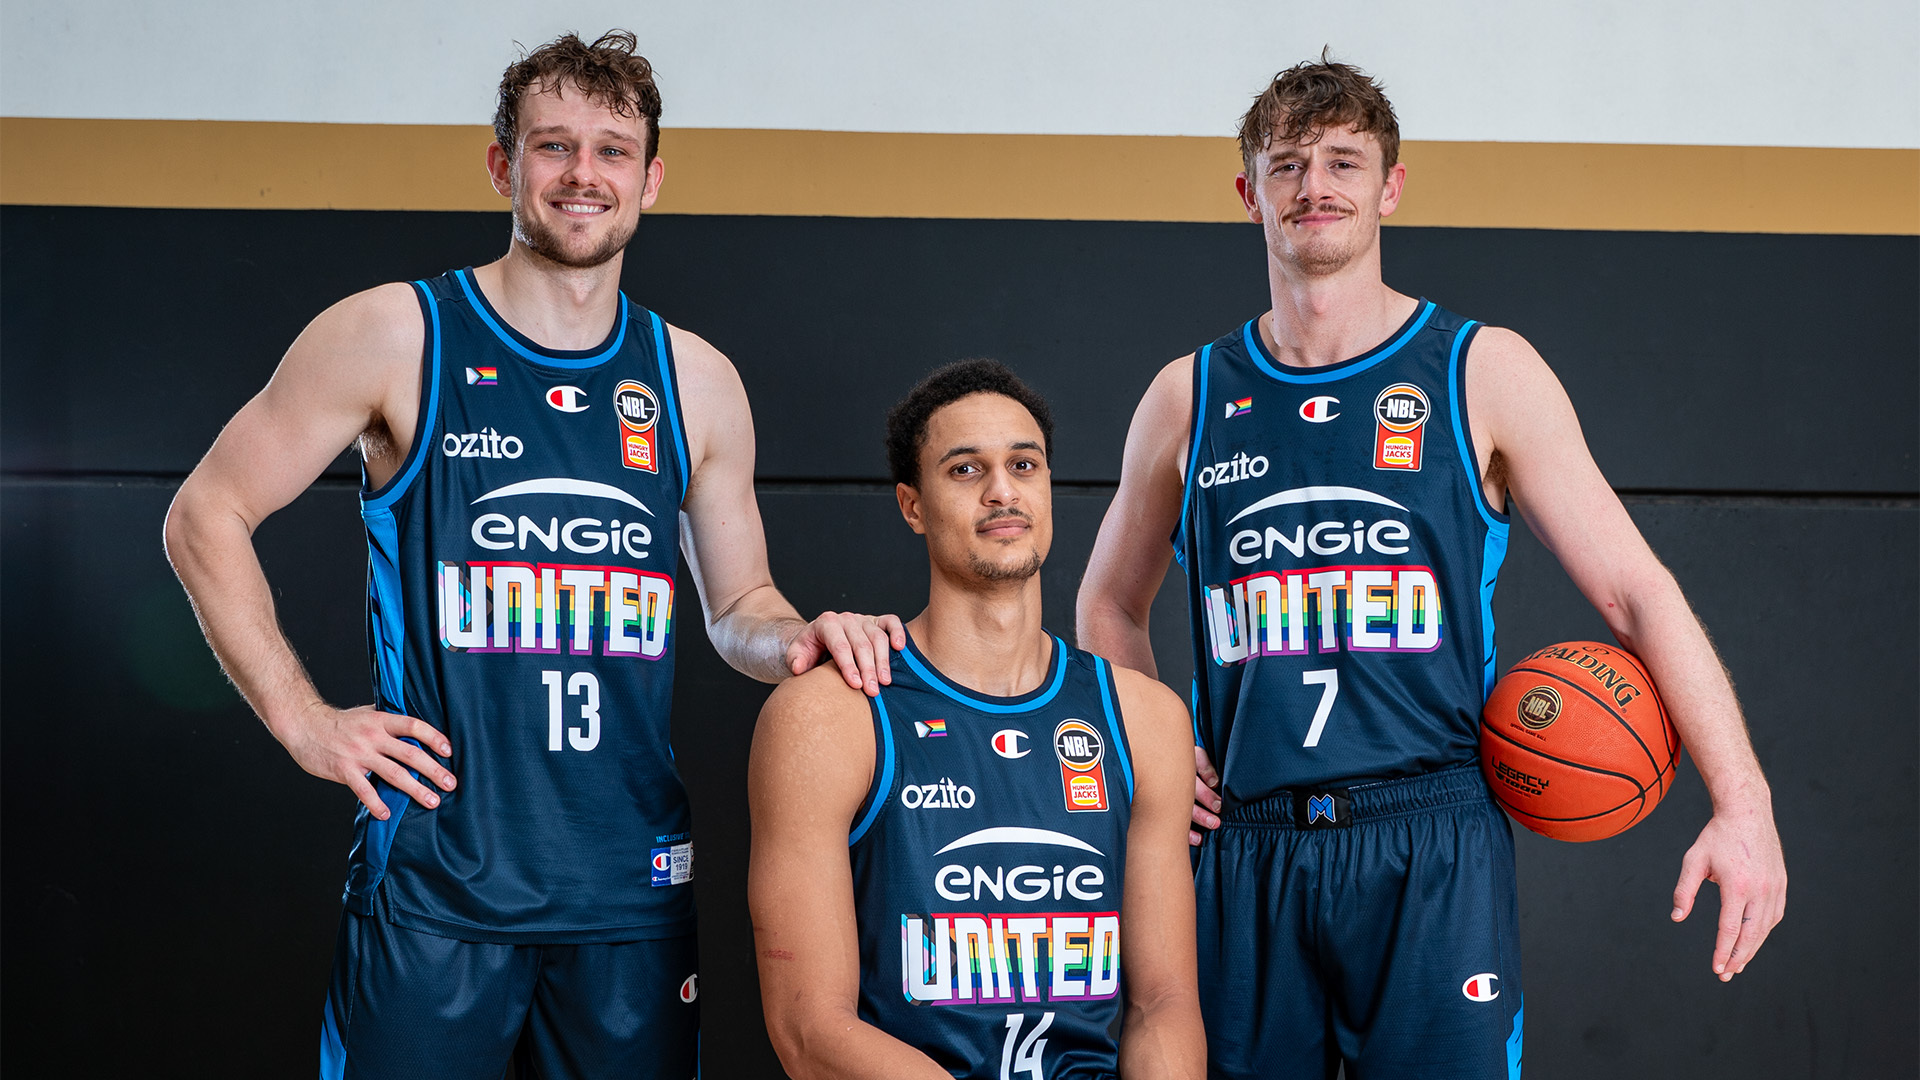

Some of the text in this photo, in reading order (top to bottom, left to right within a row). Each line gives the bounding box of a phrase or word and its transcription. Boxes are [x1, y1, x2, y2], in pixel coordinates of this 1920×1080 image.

[621, 395, 648, 419] NBL
[1386, 398, 1417, 419] NBL
[443, 426, 524, 459] ozito
[628, 443, 648, 451] HUNGRY
[1198, 451, 1269, 488] ozito
[438, 561, 675, 661] UNITED
[1204, 565, 1443, 668] UNITED
[541, 670, 601, 752] 13
[1302, 668, 1339, 748] 7
[1524, 695, 1551, 719] NBL
[1063, 735, 1093, 757] NBL
[1491, 755, 1549, 790] LEGACY
[901, 777, 976, 809] ozito
[673, 854, 689, 864] SINCE
[901, 911, 1121, 1007] UNITED
[999, 1011, 1056, 1080] 14
